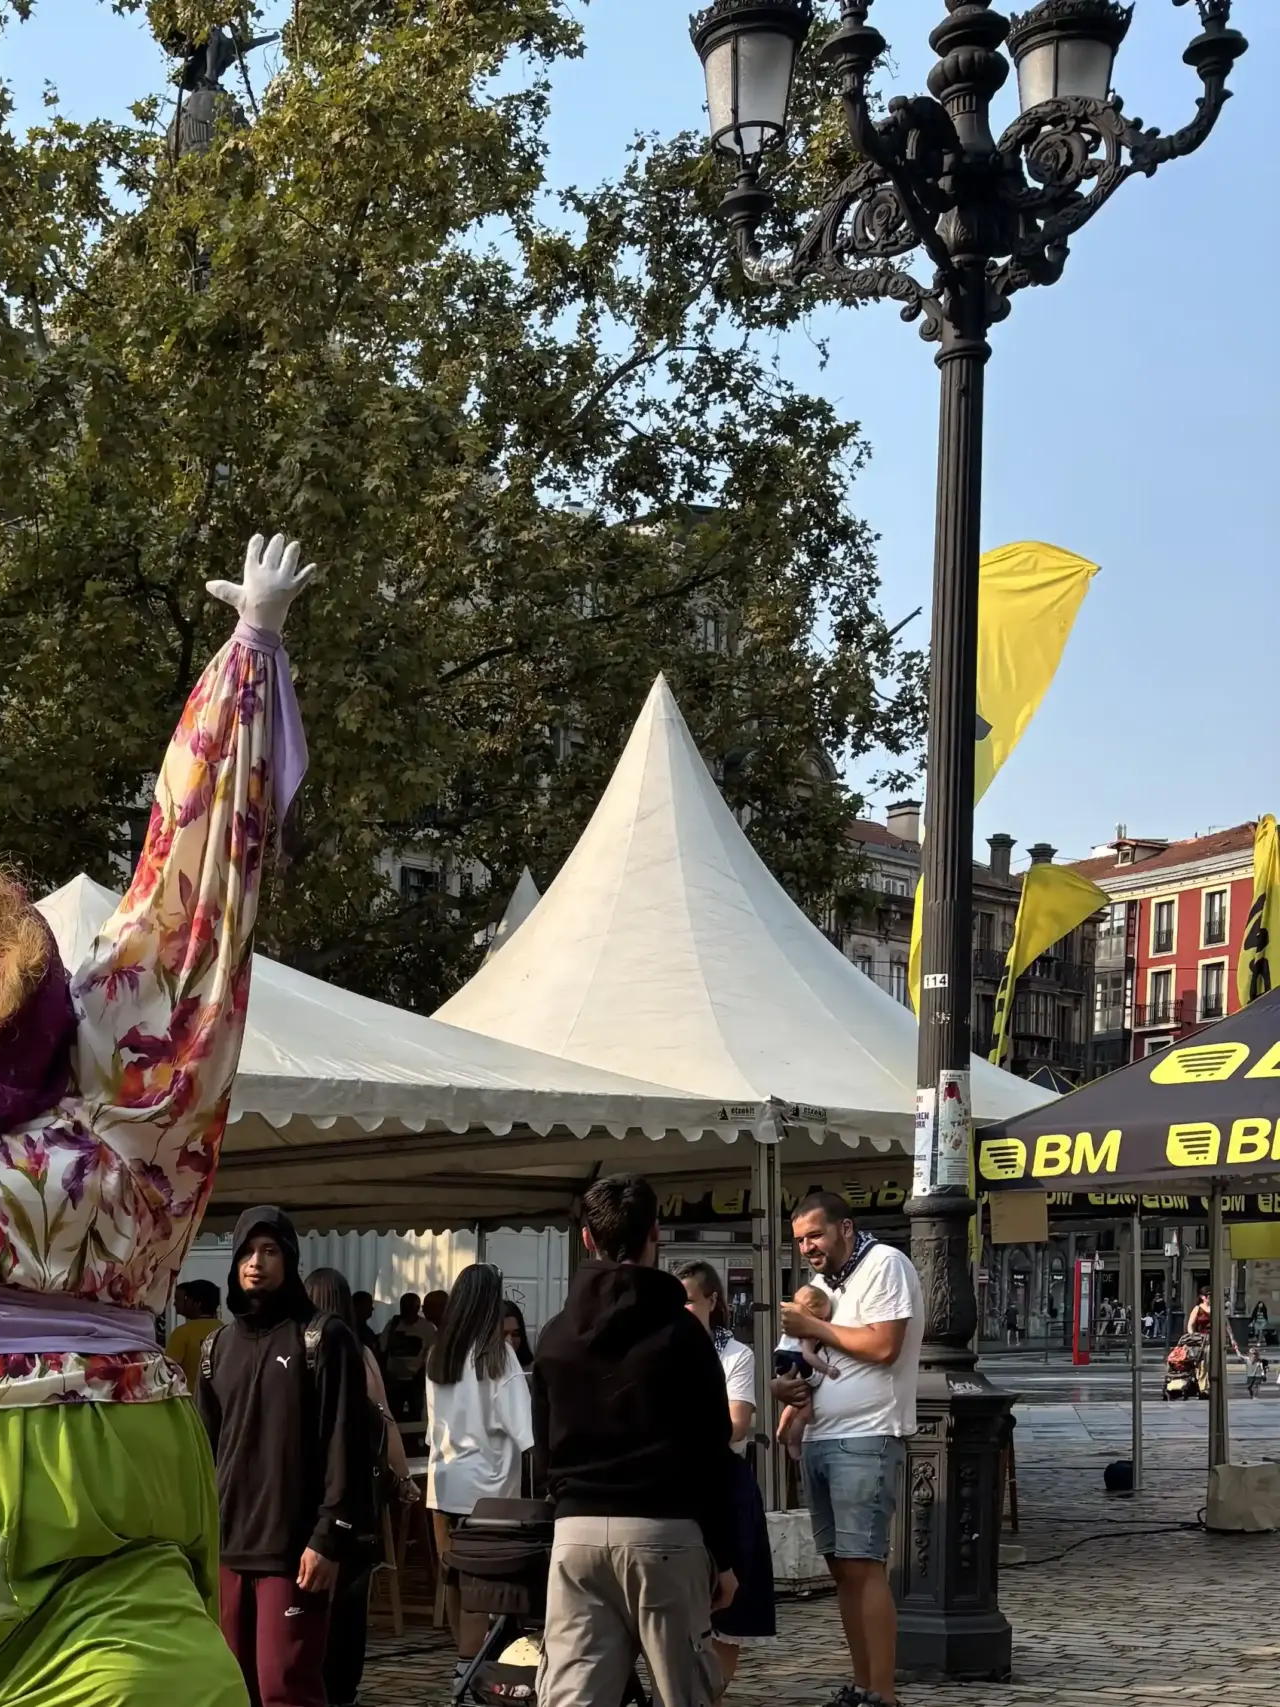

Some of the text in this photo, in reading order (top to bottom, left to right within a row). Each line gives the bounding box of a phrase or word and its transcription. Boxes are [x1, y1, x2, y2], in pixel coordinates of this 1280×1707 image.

[925, 975, 947, 987] 114
[1031, 1129, 1122, 1177] BM
[1226, 1117, 1280, 1164] B
